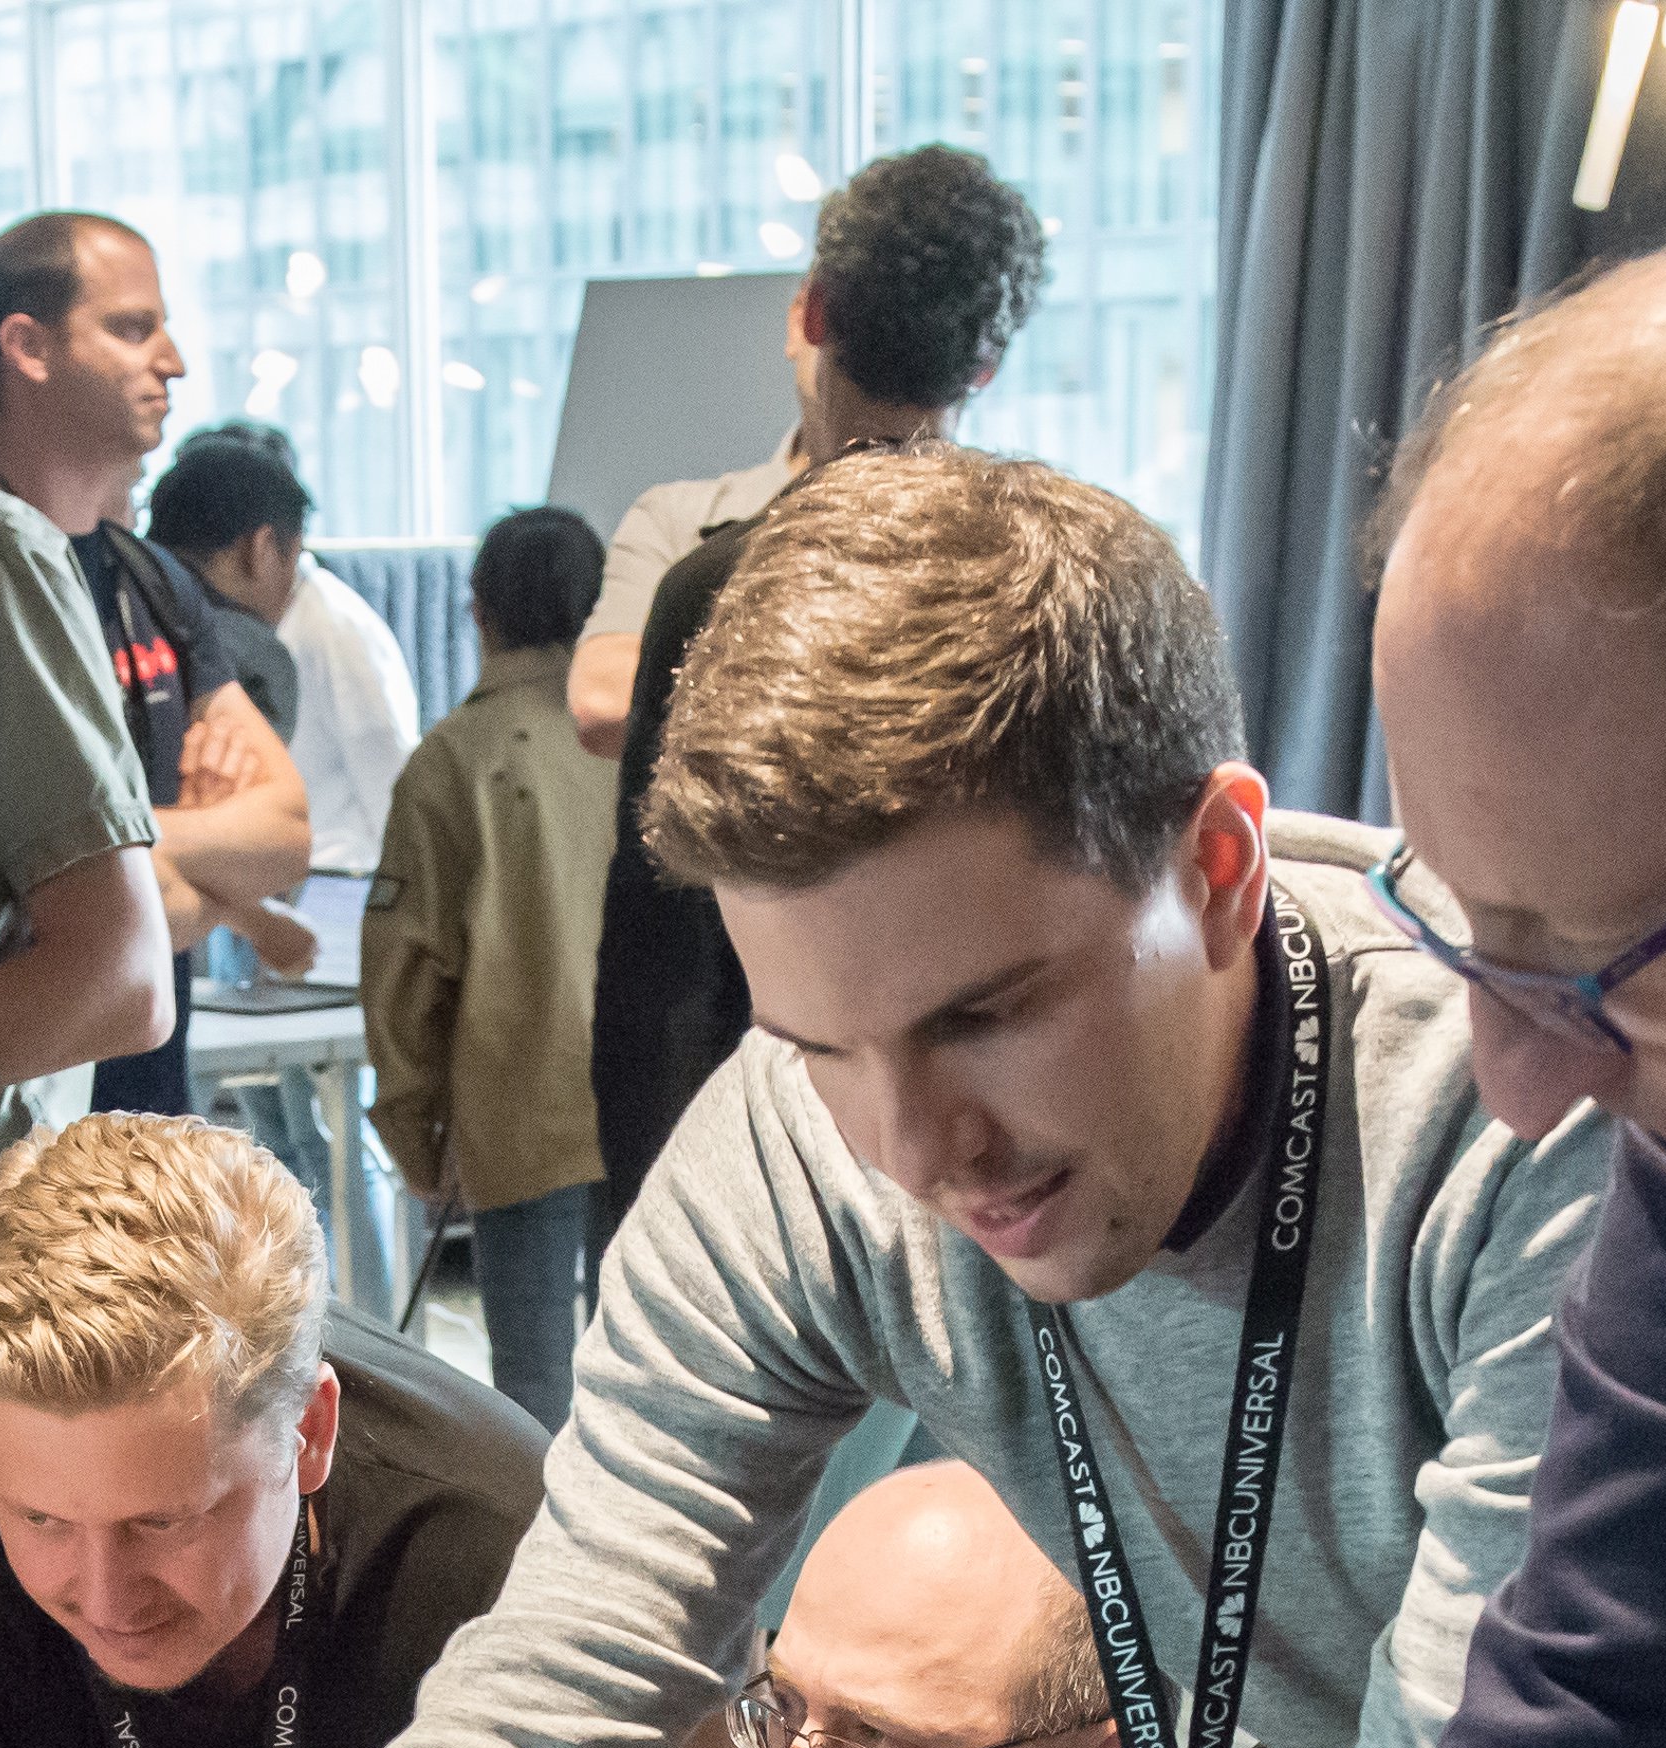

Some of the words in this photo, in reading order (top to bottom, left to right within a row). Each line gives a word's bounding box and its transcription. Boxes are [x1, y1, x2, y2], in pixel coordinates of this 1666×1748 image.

[1271, 1068, 1318, 1252] COMCAST
[1038, 1327, 1098, 1498] COMCAST
[1223, 1331, 1285, 1589] NBCUNIVERSAL
